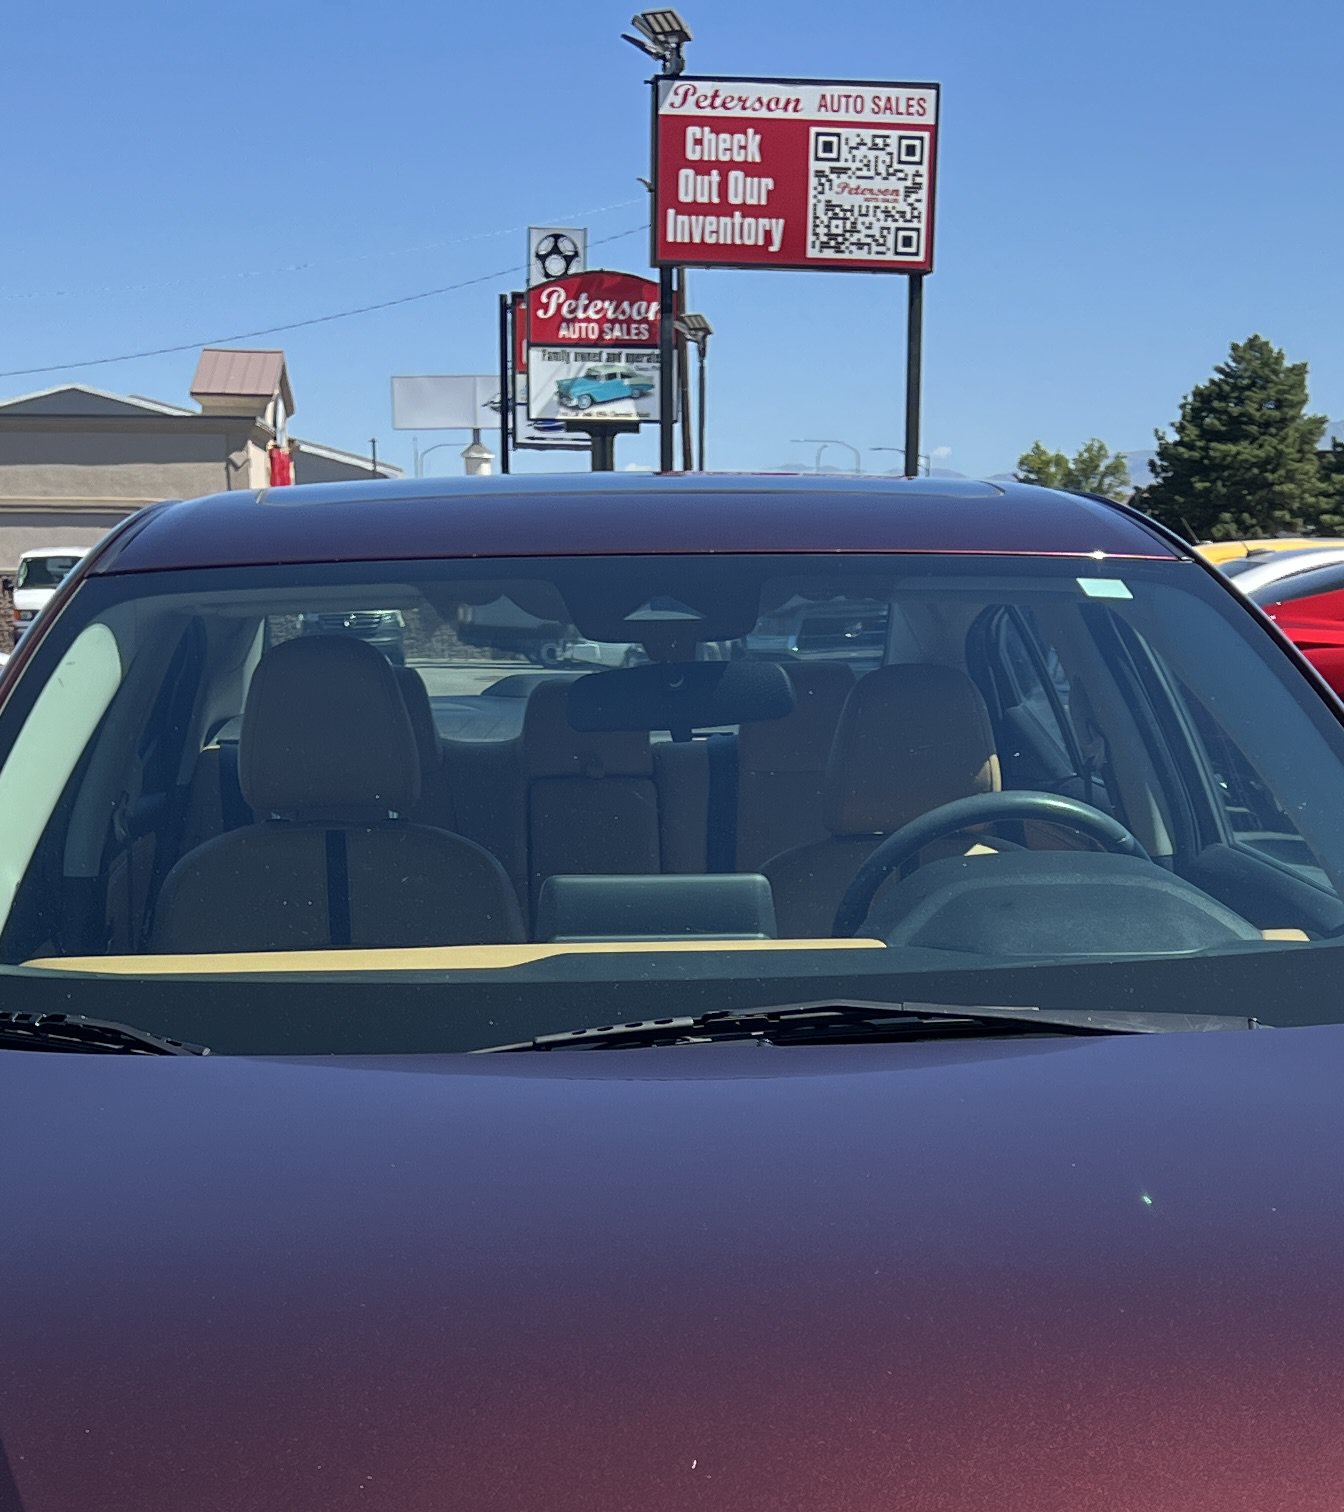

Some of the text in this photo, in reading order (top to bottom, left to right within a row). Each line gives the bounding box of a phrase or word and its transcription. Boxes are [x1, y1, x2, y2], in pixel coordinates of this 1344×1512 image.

[669, 82, 928, 117] Peterson AUTO SALES
[685, 125, 763, 163] Check
[678, 168, 775, 206] Out Our
[665, 207, 786, 253] Inventory
[558, 321, 650, 341] AUTO SALES
